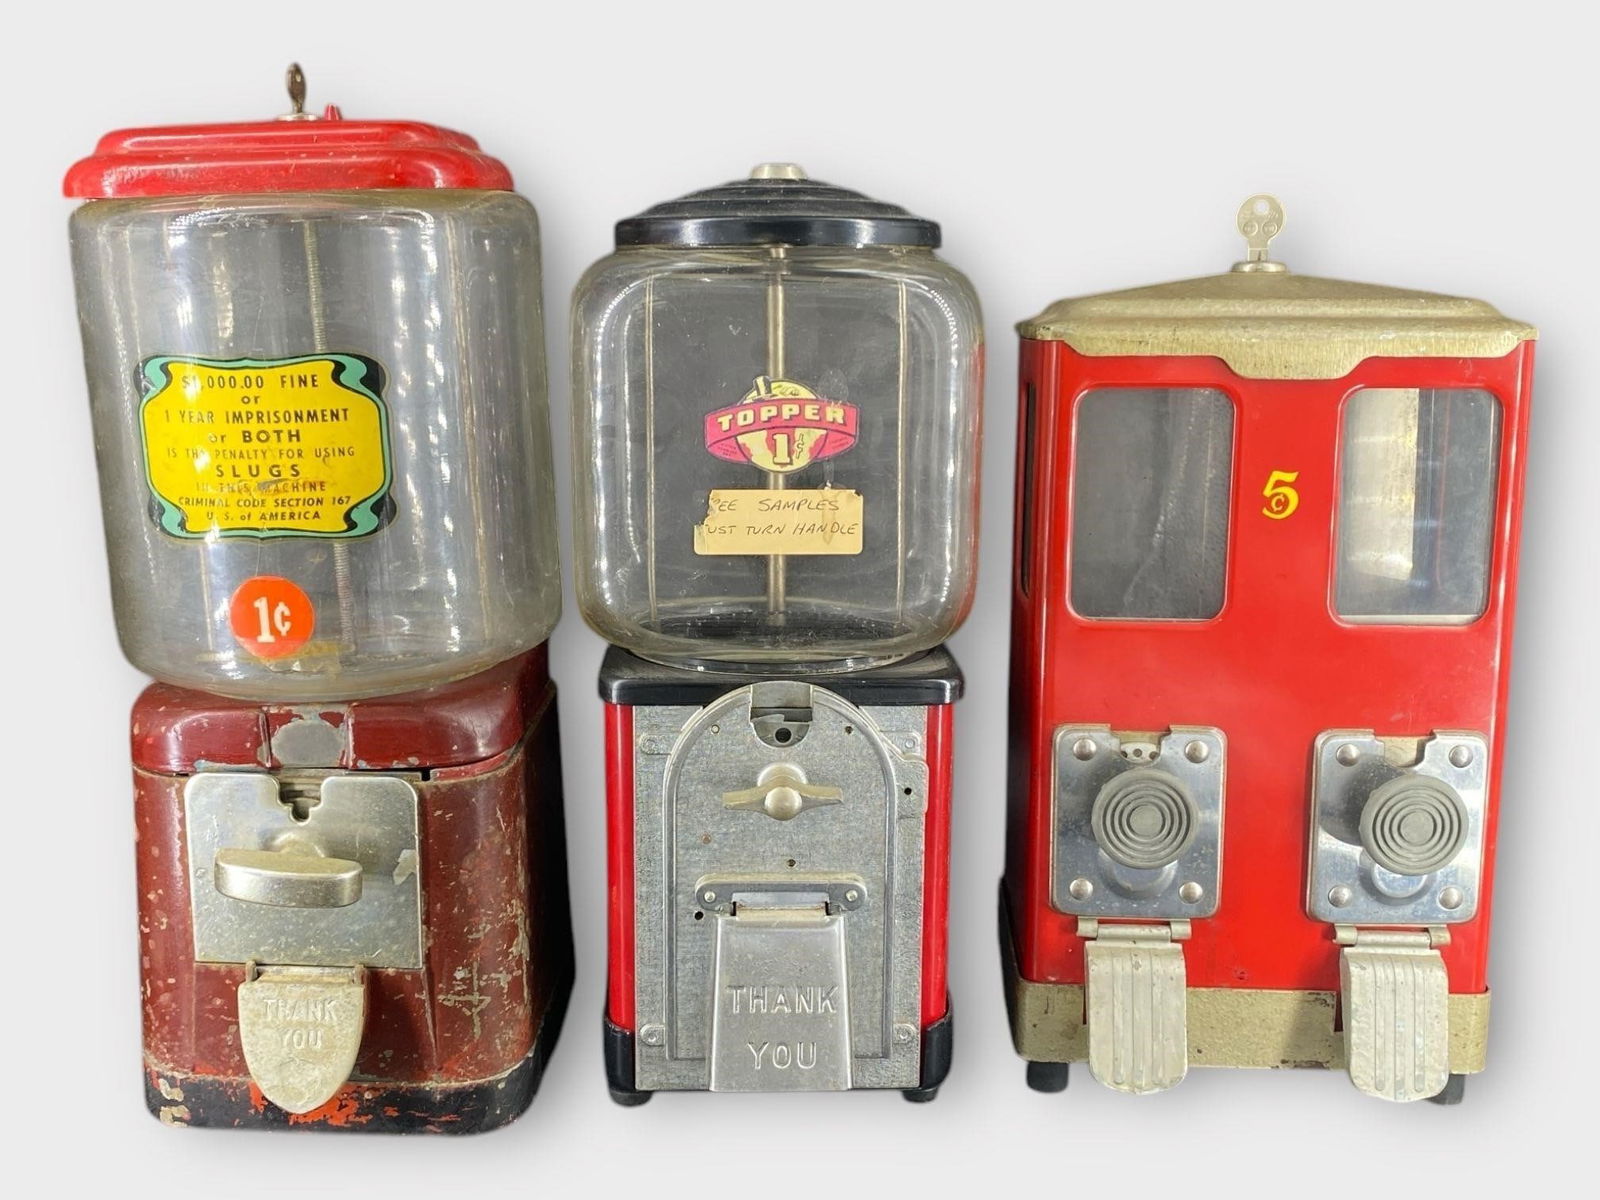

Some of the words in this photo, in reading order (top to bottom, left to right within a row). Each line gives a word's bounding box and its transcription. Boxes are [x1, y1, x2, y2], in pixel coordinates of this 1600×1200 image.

[280, 374, 319, 388] FINE
[241, 395, 261, 405] or
[165, 409, 171, 423] 1
[179, 409, 214, 424] YEAR
[225, 407, 349, 424] IMPRISONMENT
[717, 403, 846, 432] TOPPER
[207, 432, 227, 443] or
[242, 429, 301, 444] BOTH
[167, 447, 177, 459] IS
[215, 448, 268, 460] PENALTY
[279, 447, 304, 459] FOR
[315, 446, 355, 458] USING
[216, 463, 301, 478] SLUGS
[178, 496, 230, 508] CRIMINAL
[236, 498, 266, 508] CODE
[274, 497, 324, 508] SECTION
[332, 495, 351, 505] 167
[758, 498, 840, 512] SAMPLES
[240, 511, 252, 521] of
[260, 511, 321, 521] AMERICA
[705, 524, 737, 535] UST
[746, 523, 786, 535] TURN
[792, 522, 859, 536] HANDLE
[253, 596, 292, 643] 1¢
[726, 984, 838, 1015] THANK
[263, 998, 338, 1021] THANK
[282, 1027, 322, 1050] YOU
[747, 1041, 817, 1070] YOU
